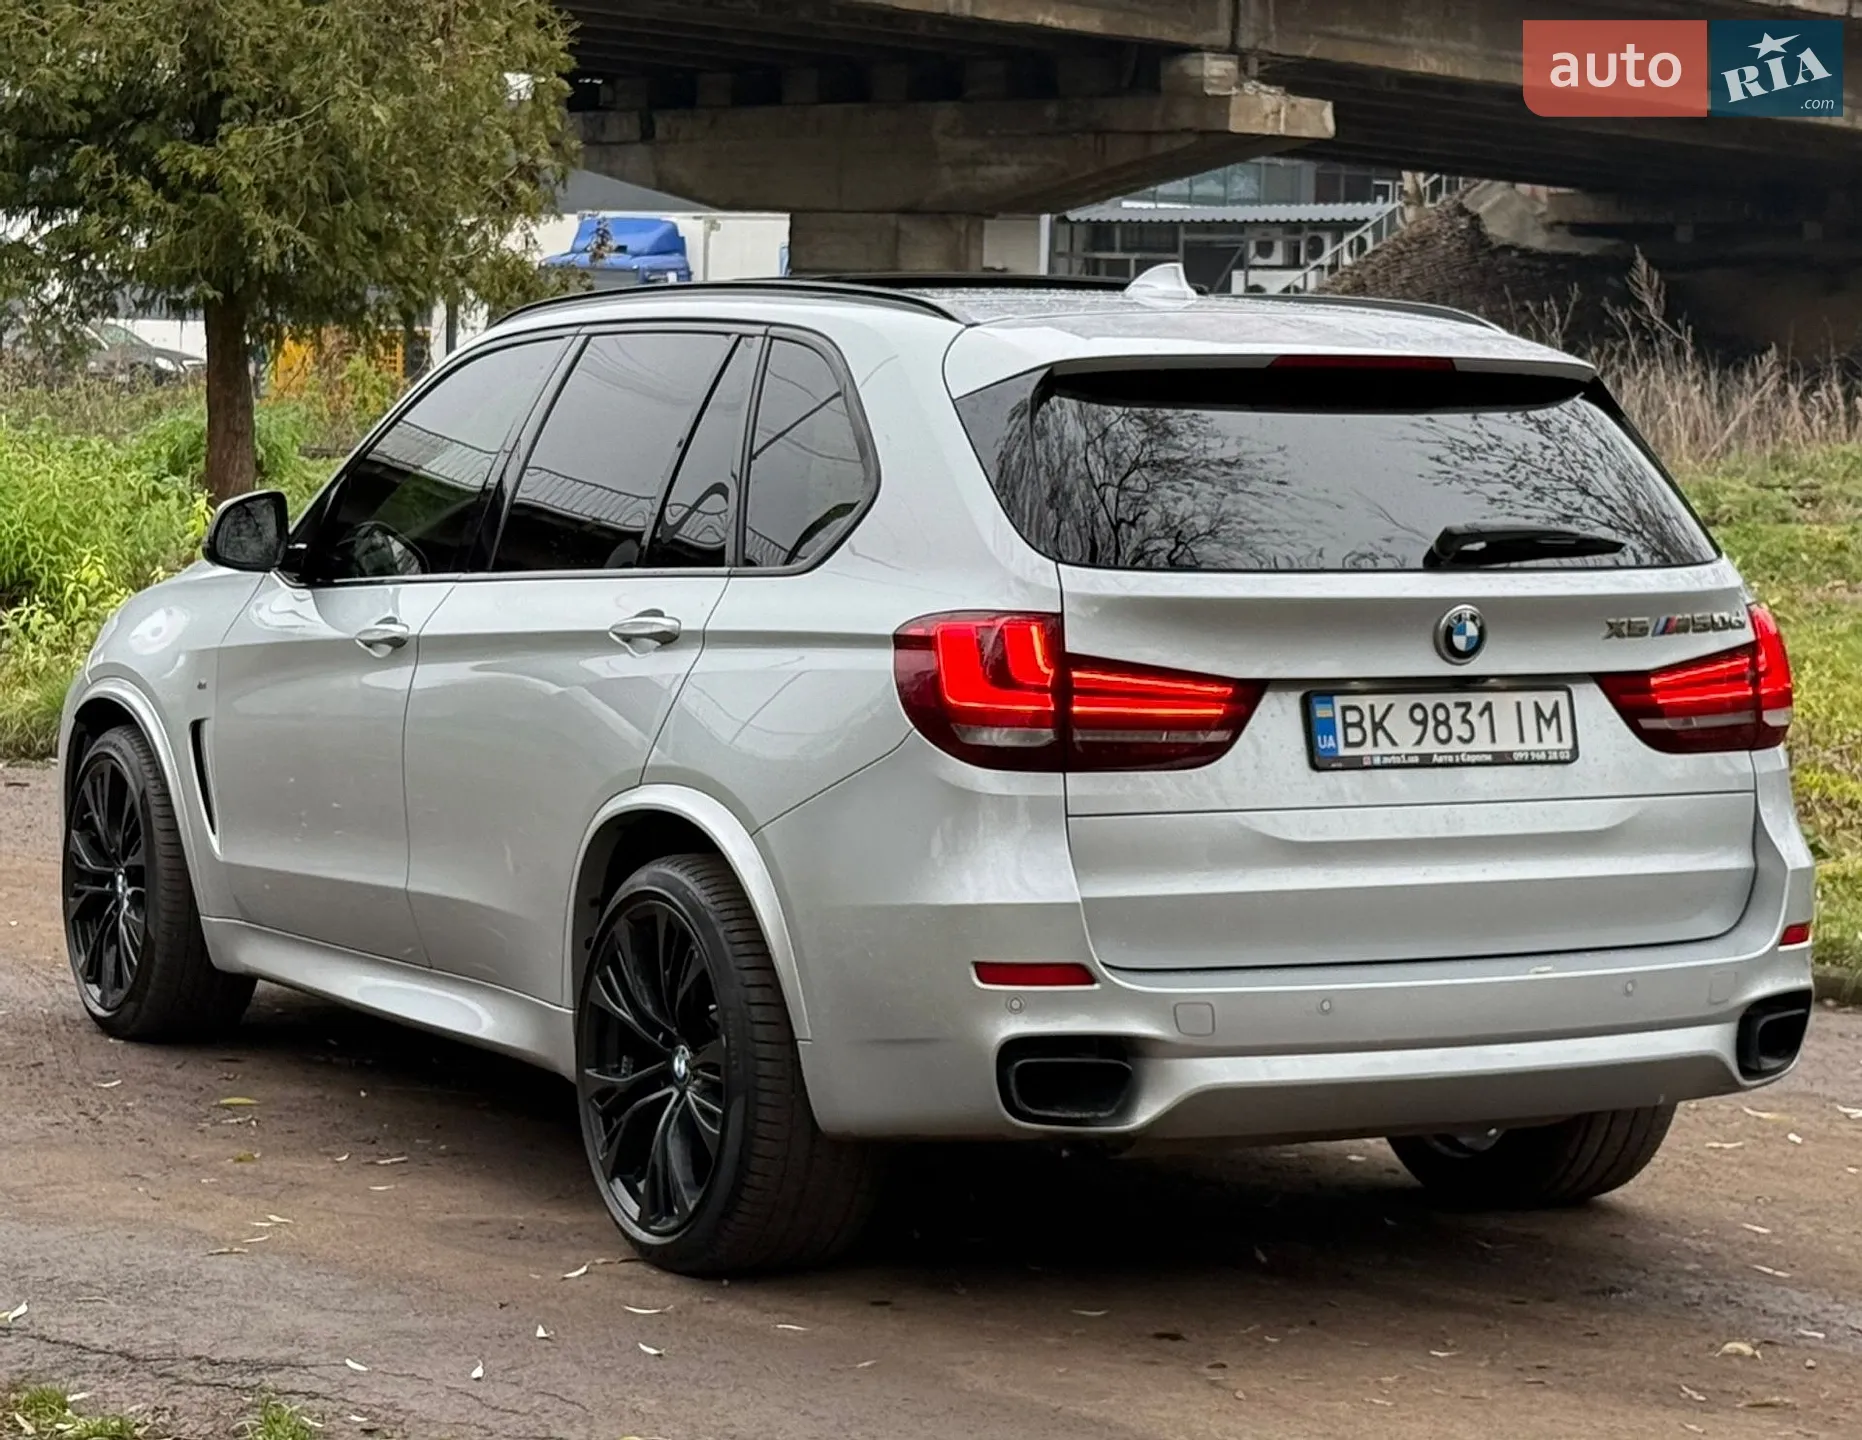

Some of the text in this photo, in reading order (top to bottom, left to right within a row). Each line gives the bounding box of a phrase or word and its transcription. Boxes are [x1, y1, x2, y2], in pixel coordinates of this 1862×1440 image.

[1340, 699, 1564, 748] BK 9831 IM
[1317, 735, 1336, 749] UA
